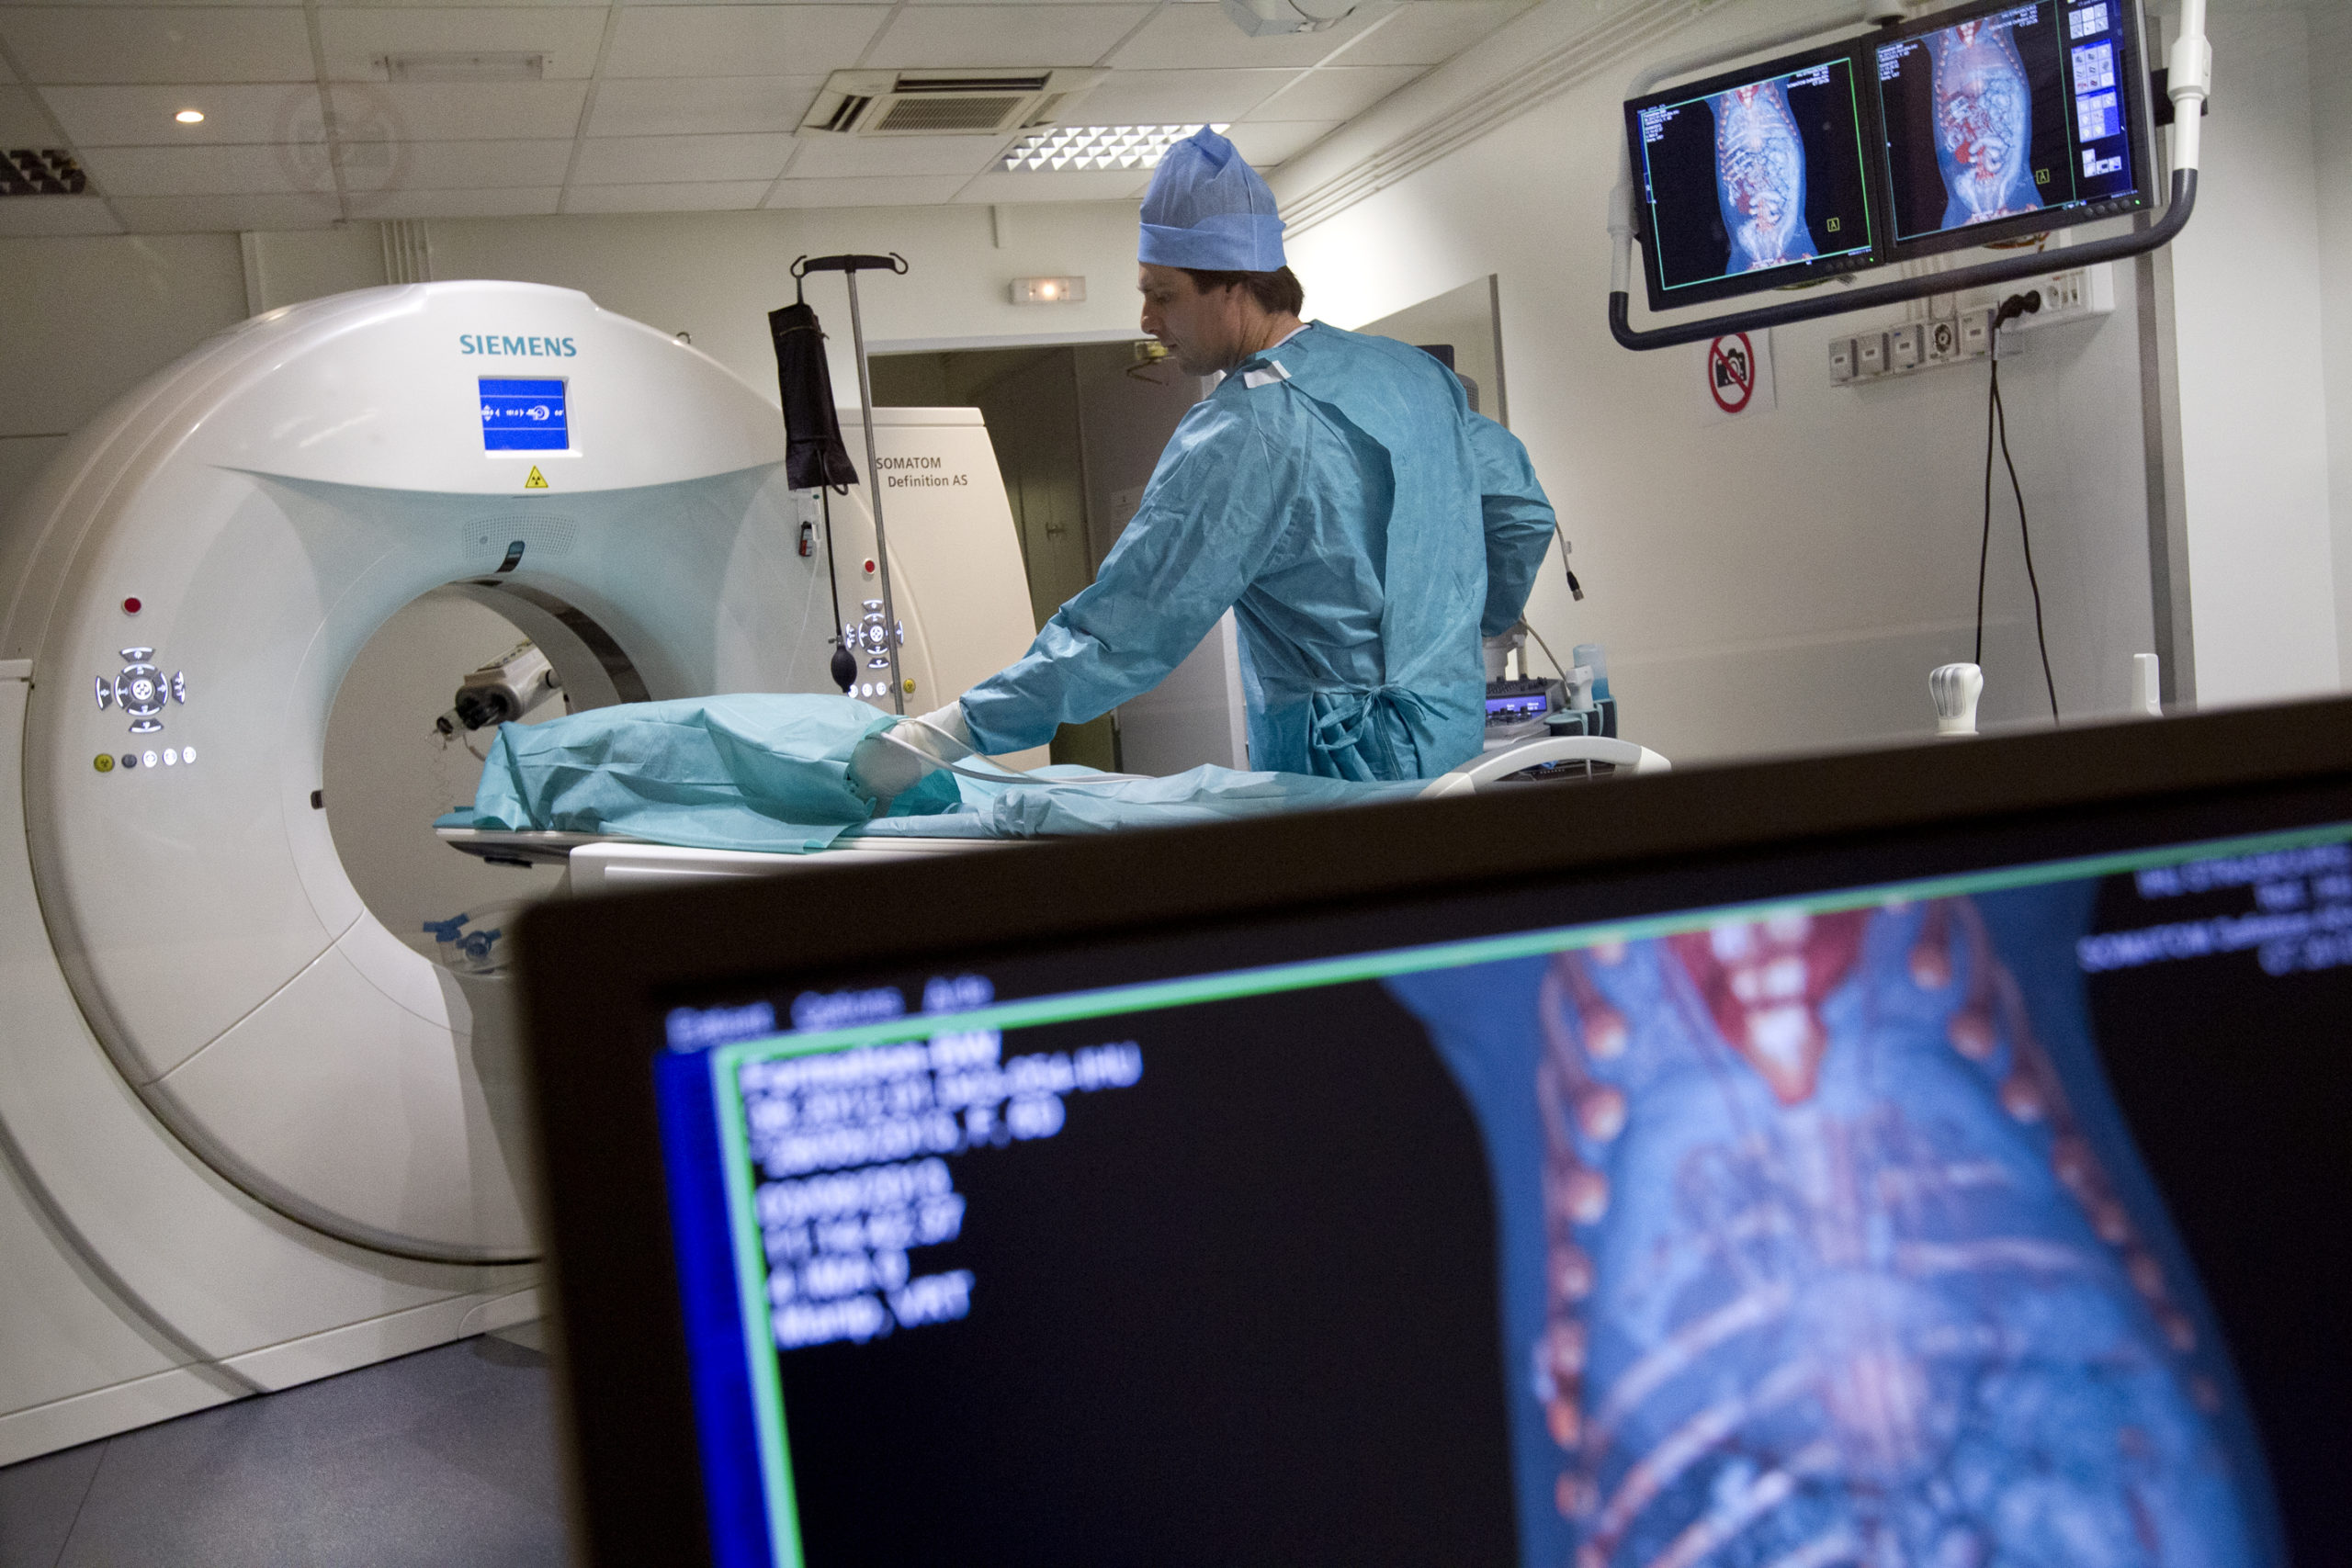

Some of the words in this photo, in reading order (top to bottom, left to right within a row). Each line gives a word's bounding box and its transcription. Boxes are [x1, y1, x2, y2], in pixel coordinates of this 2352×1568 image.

[459, 334, 577, 357] SIEMENS
[876, 457, 942, 470] SOMATOM
[888, 474, 949, 488] Definition
[953, 474, 968, 486] AS
